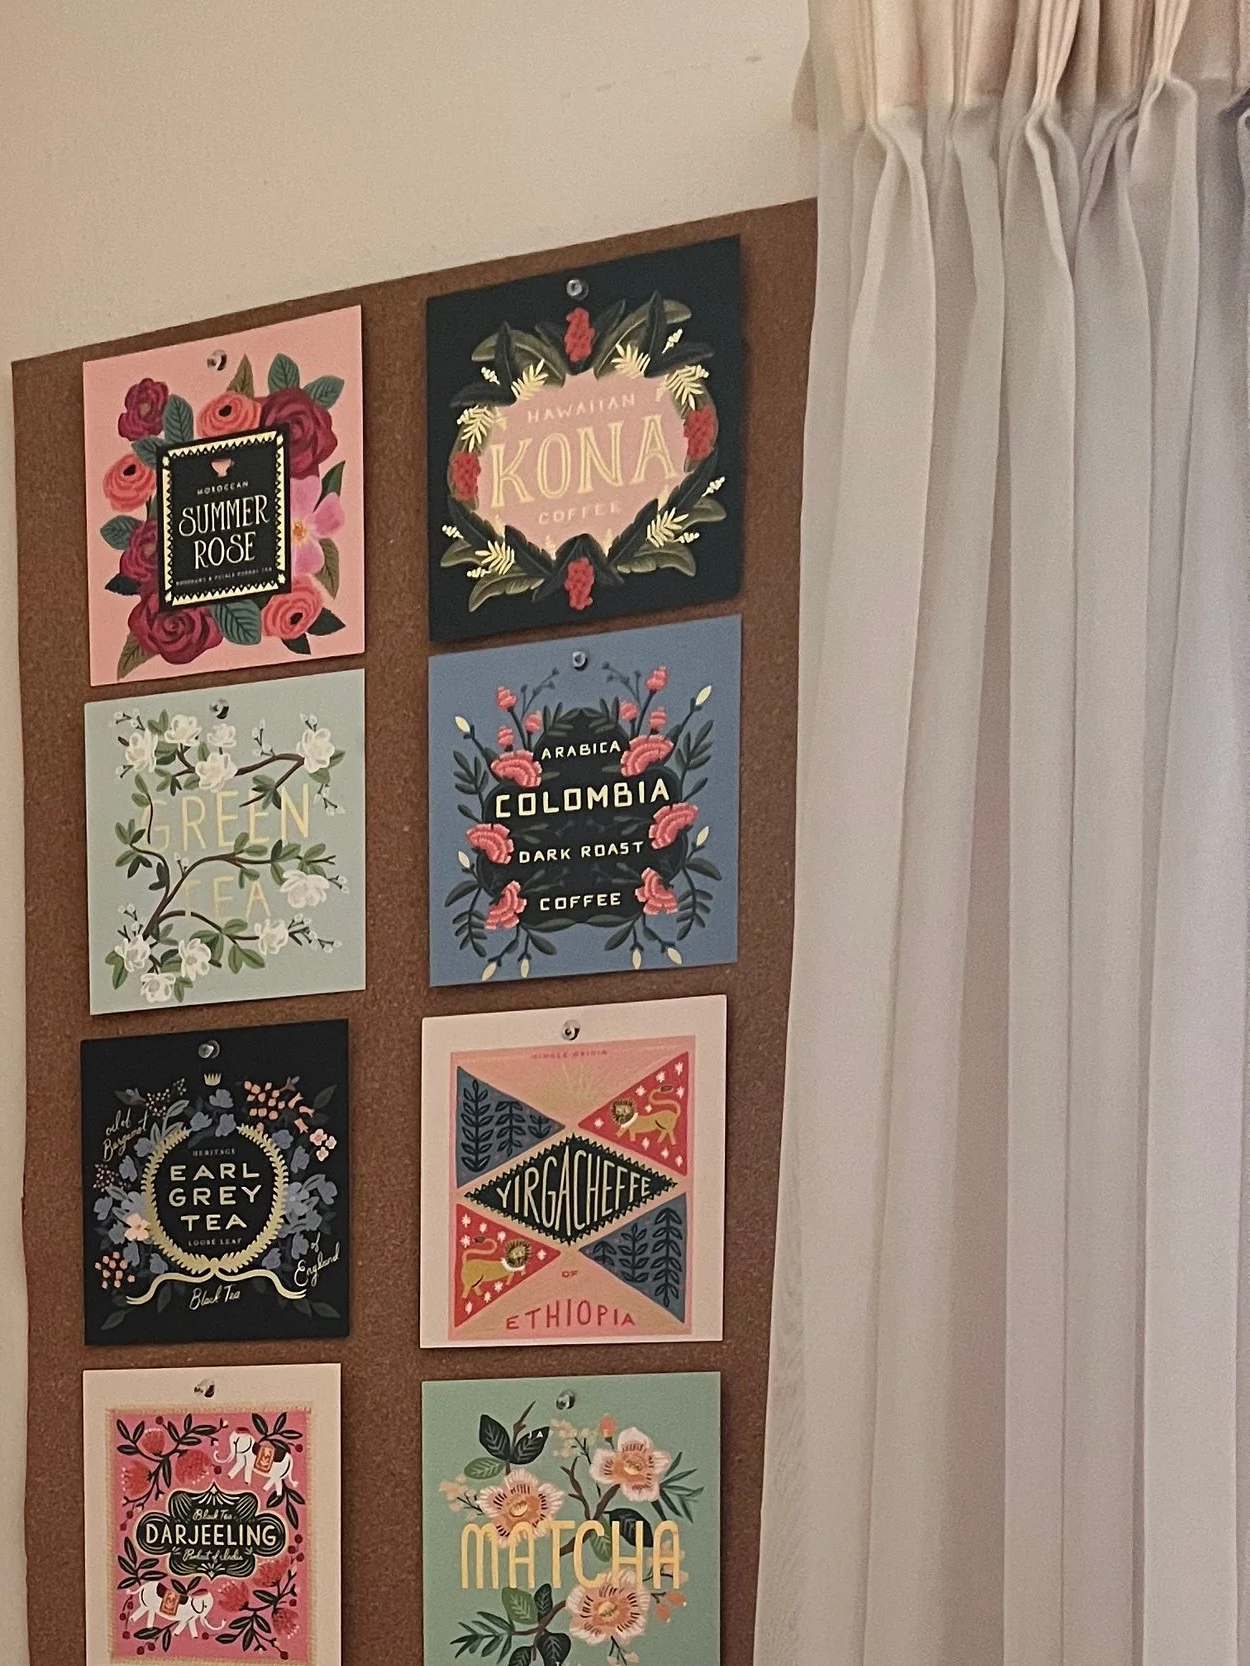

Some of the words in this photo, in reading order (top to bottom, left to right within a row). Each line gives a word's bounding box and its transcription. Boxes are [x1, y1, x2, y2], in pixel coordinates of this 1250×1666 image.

[527, 392, 635, 423] HAWAIIAN
[490, 413, 680, 509] KONA
[196, 481, 249, 496] MOROCCAN
[178, 494, 270, 537] SUMMER
[538, 500, 623, 526] COFFEE
[193, 531, 257, 570] ROSE
[541, 740, 621, 760] ARABICA
[495, 778, 670, 819] COLOMBIA
[140, 783, 310, 852] GREEN
[519, 847, 571, 864] DARK
[581, 841, 644, 858] ROAST
[182, 875, 271, 922] TEA
[540, 893, 621, 911] COFFEE
[193, 1147, 236, 1157] HERITAGE
[170, 1162, 260, 1181] EARL
[168, 1184, 262, 1207] GREY
[496, 1145, 652, 1236] YIRGACHEFFE
[180, 1213, 248, 1232] TEA
[188, 1238, 216, 1247] LOOSE
[220, 1237, 243, 1245] LEAF
[293, 1241, 341, 1287] England
[561, 1269, 579, 1278] OF
[189, 1284, 223, 1311] Black
[224, 1283, 242, 1303] Tea
[505, 1299, 637, 1331] ETHIOPIA
[145, 1524, 278, 1547] DARJEELING
[461, 1519, 681, 1590] MATCHA
